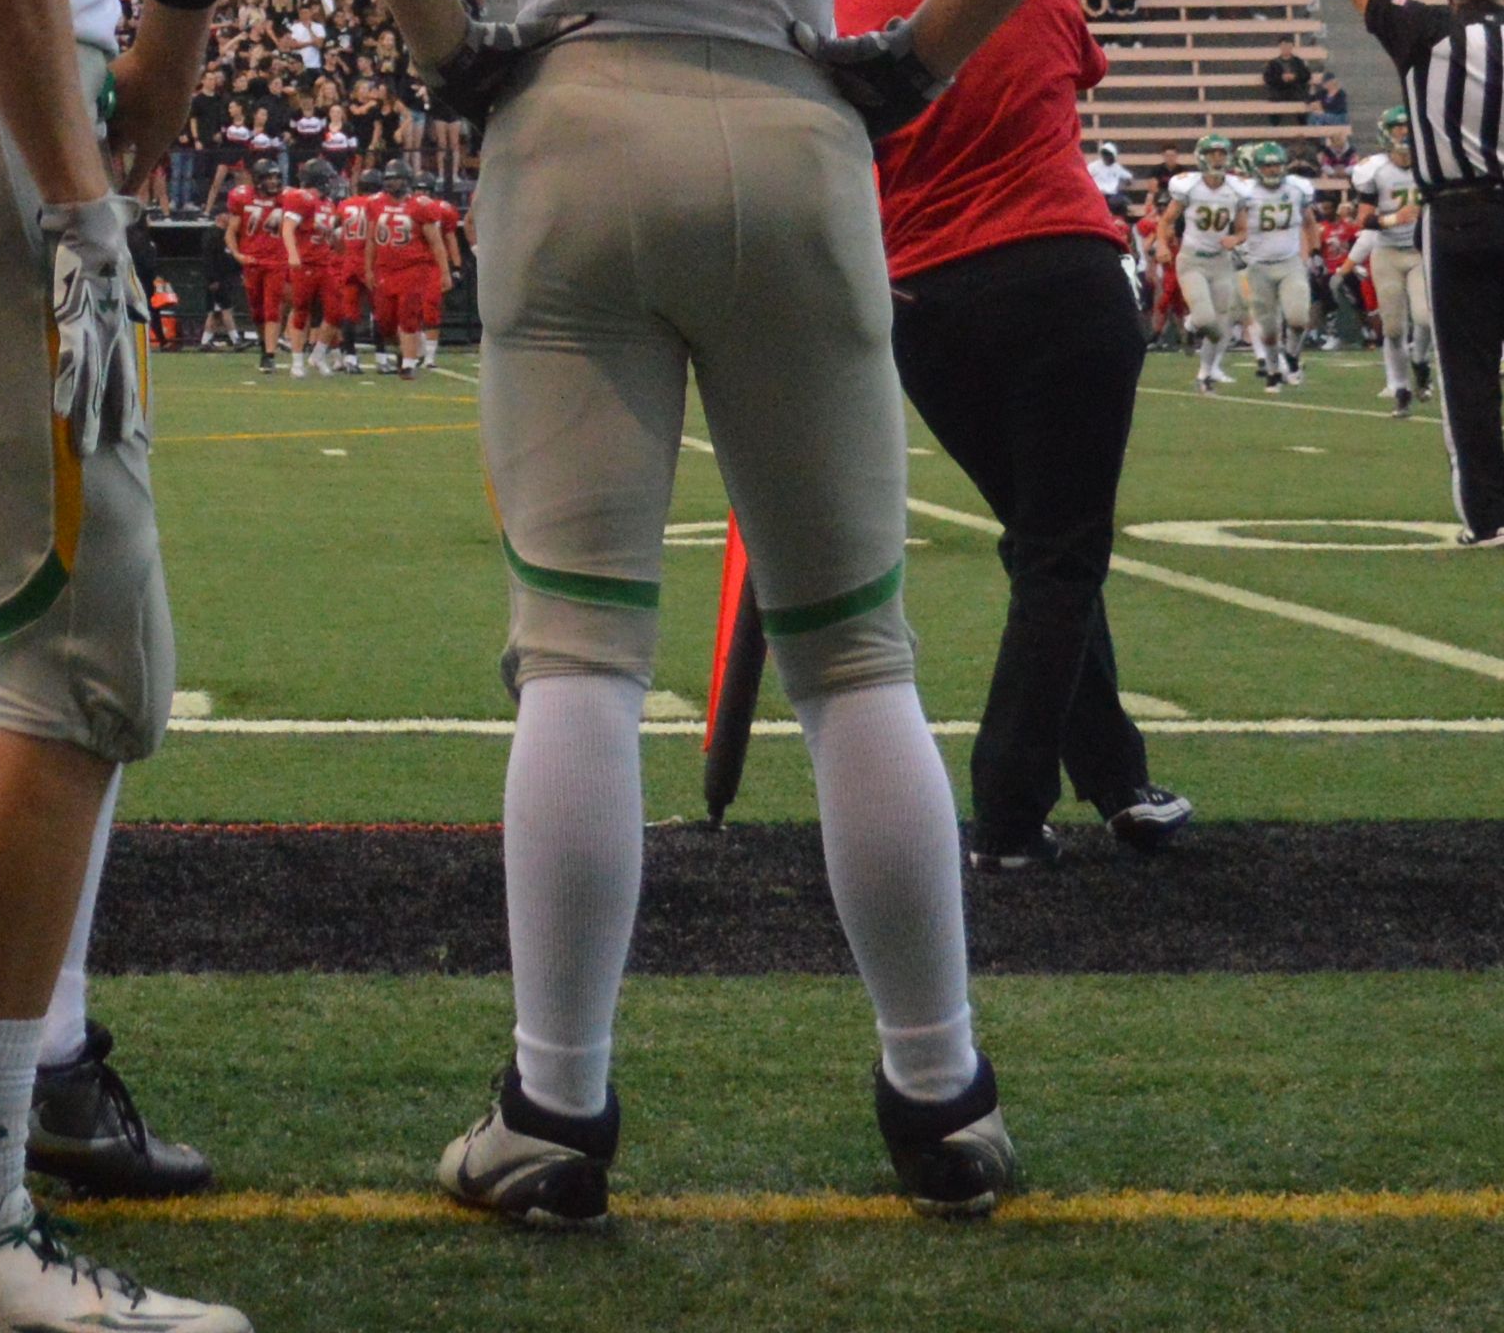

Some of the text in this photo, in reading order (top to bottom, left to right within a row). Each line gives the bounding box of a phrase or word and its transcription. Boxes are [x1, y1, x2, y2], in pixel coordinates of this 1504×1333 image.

[242, 204, 284, 239] 74
[375, 212, 413, 247] 63
[1195, 205, 1231, 232] 30
[1260, 203, 1293, 232] 67
